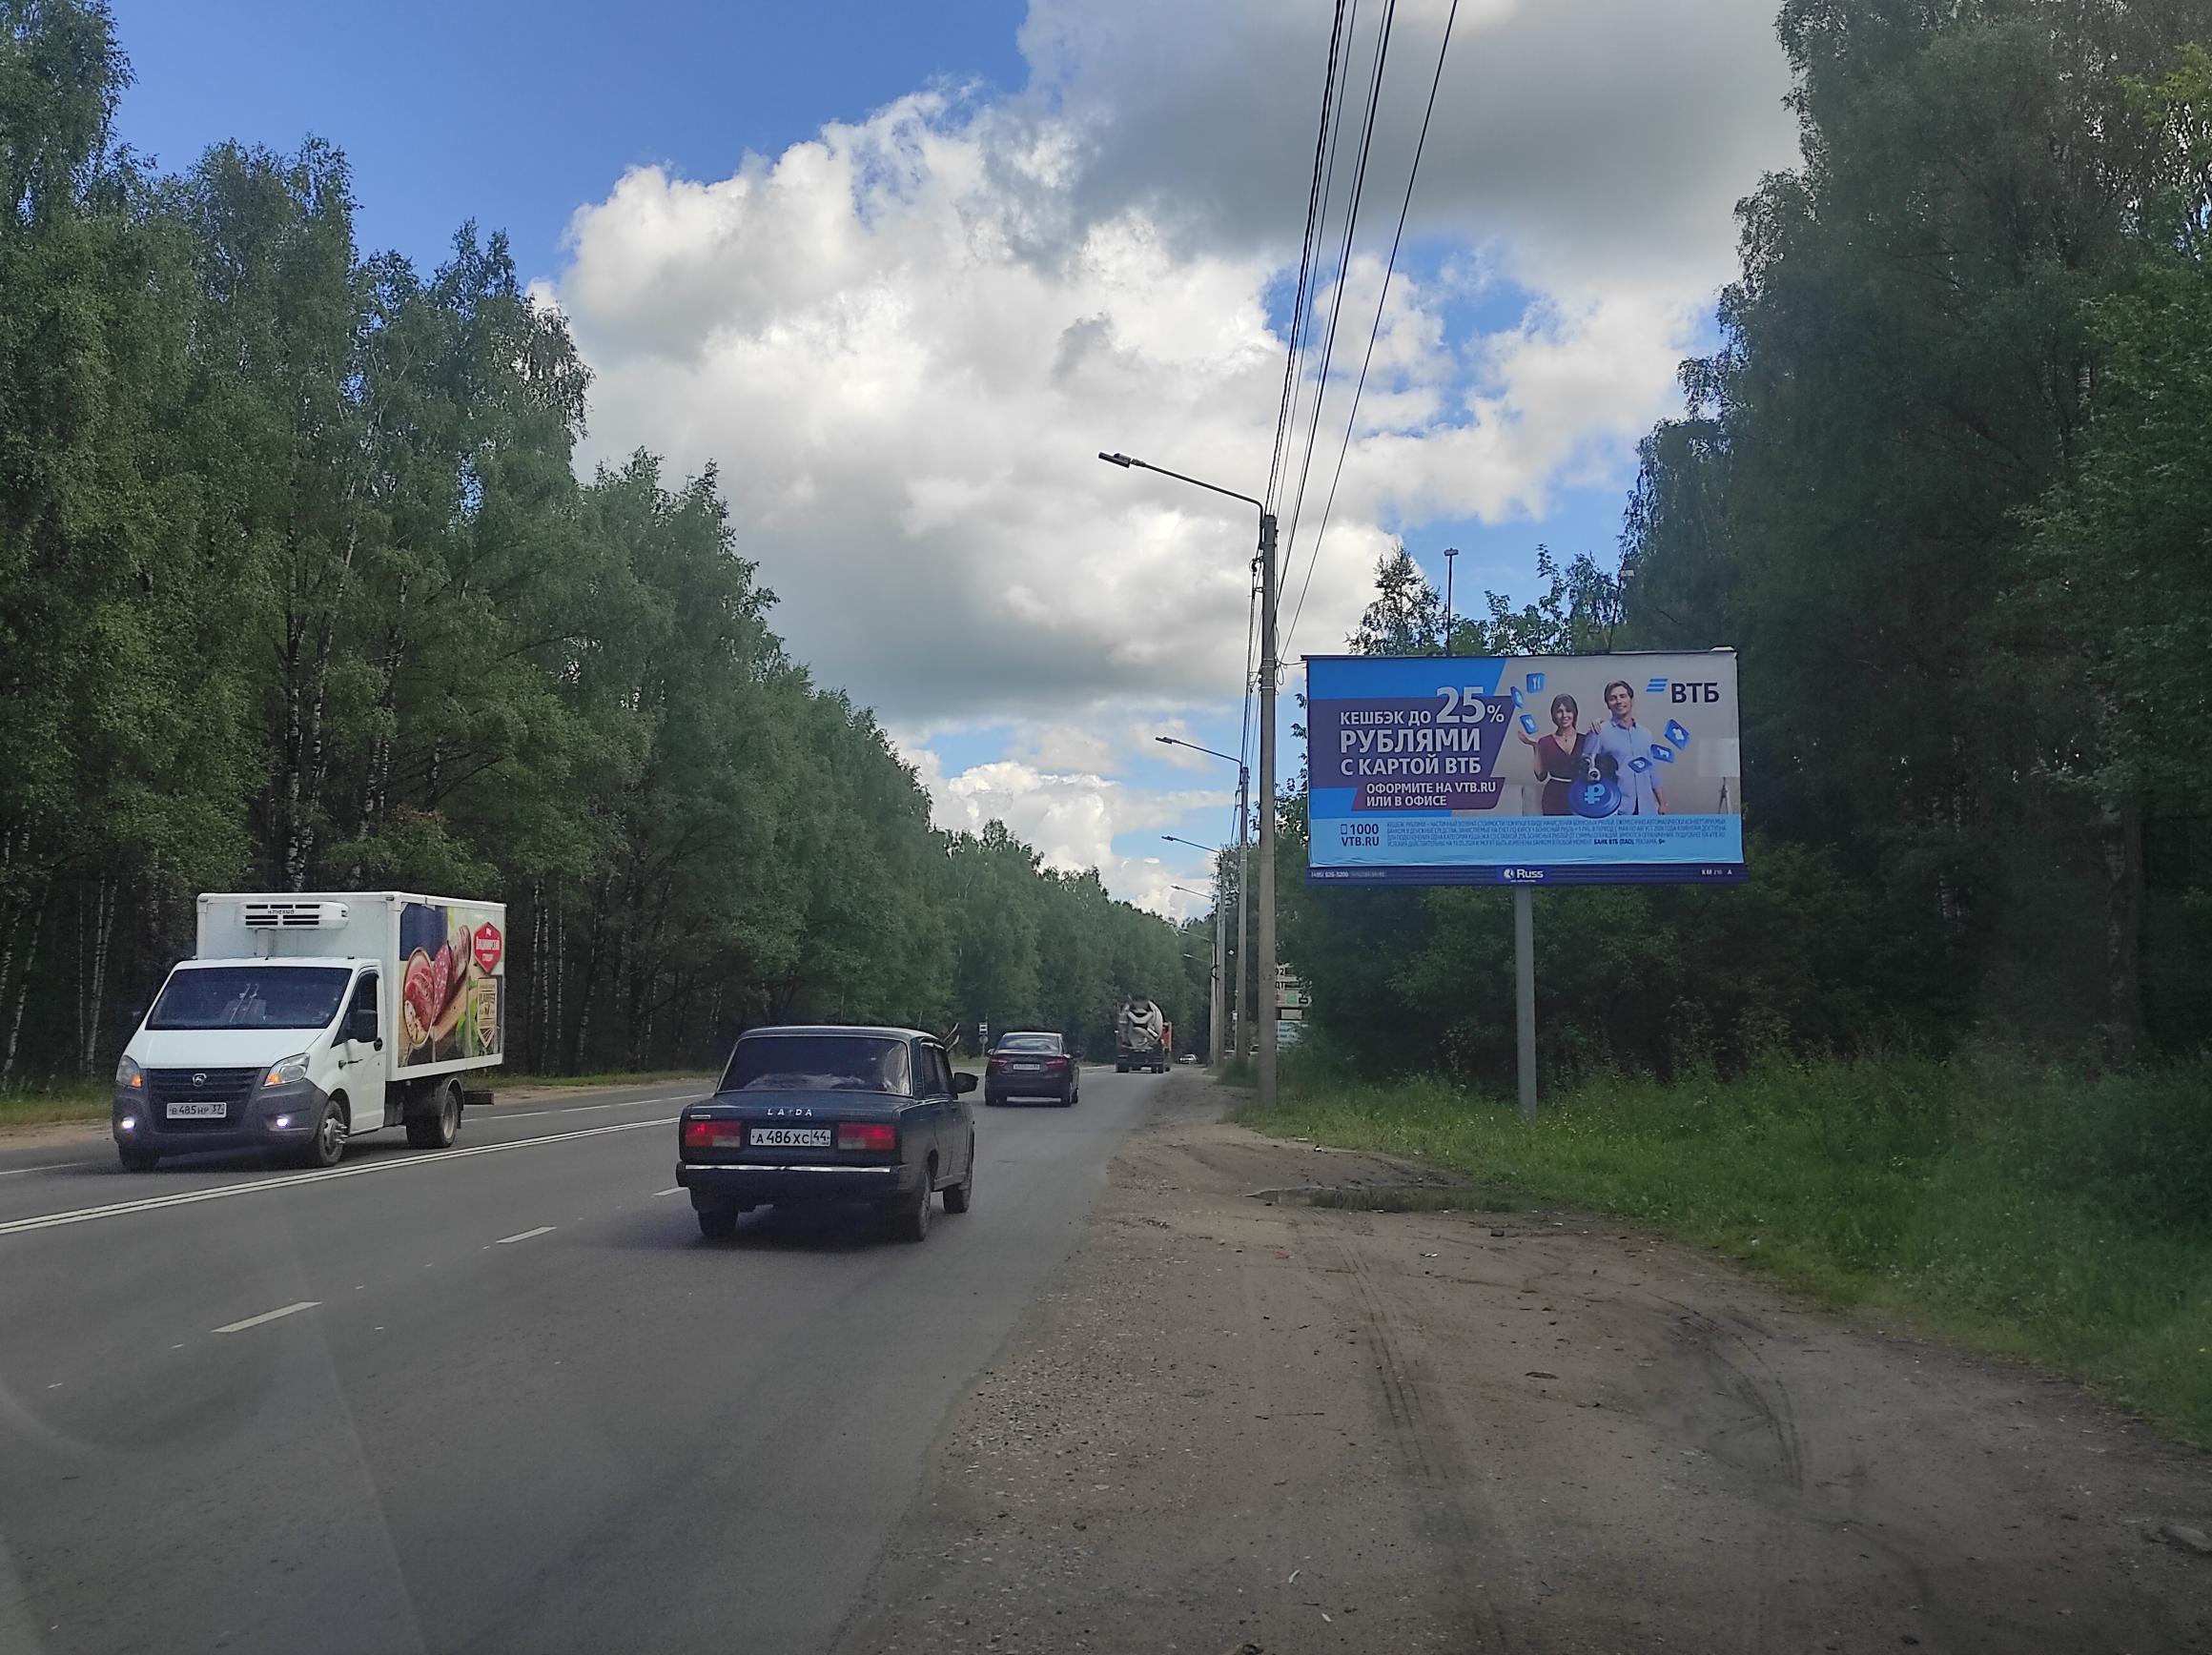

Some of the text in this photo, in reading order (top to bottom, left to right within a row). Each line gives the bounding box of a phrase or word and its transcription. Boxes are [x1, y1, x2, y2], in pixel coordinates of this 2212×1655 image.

[1671, 682, 1720, 704] ВТБ
[1340, 685, 1505, 726] КЕШБЭК ДО 25%
[1340, 727, 1481, 754] РУБЛЯМИ
[1341, 754, 1482, 776] С КАРТОЙ ВТБ
[1366, 782, 1496, 794] ОФОРМИТЕ НА VTB.RU
[1366, 795, 1447, 807] ИЛИ В ОФИСЕ
[1350, 823, 1380, 835] 1000
[1342, 836, 1380, 847] VTB.RU
[1516, 868, 1544, 879] Russ
[767, 1108, 812, 1117] LADA
